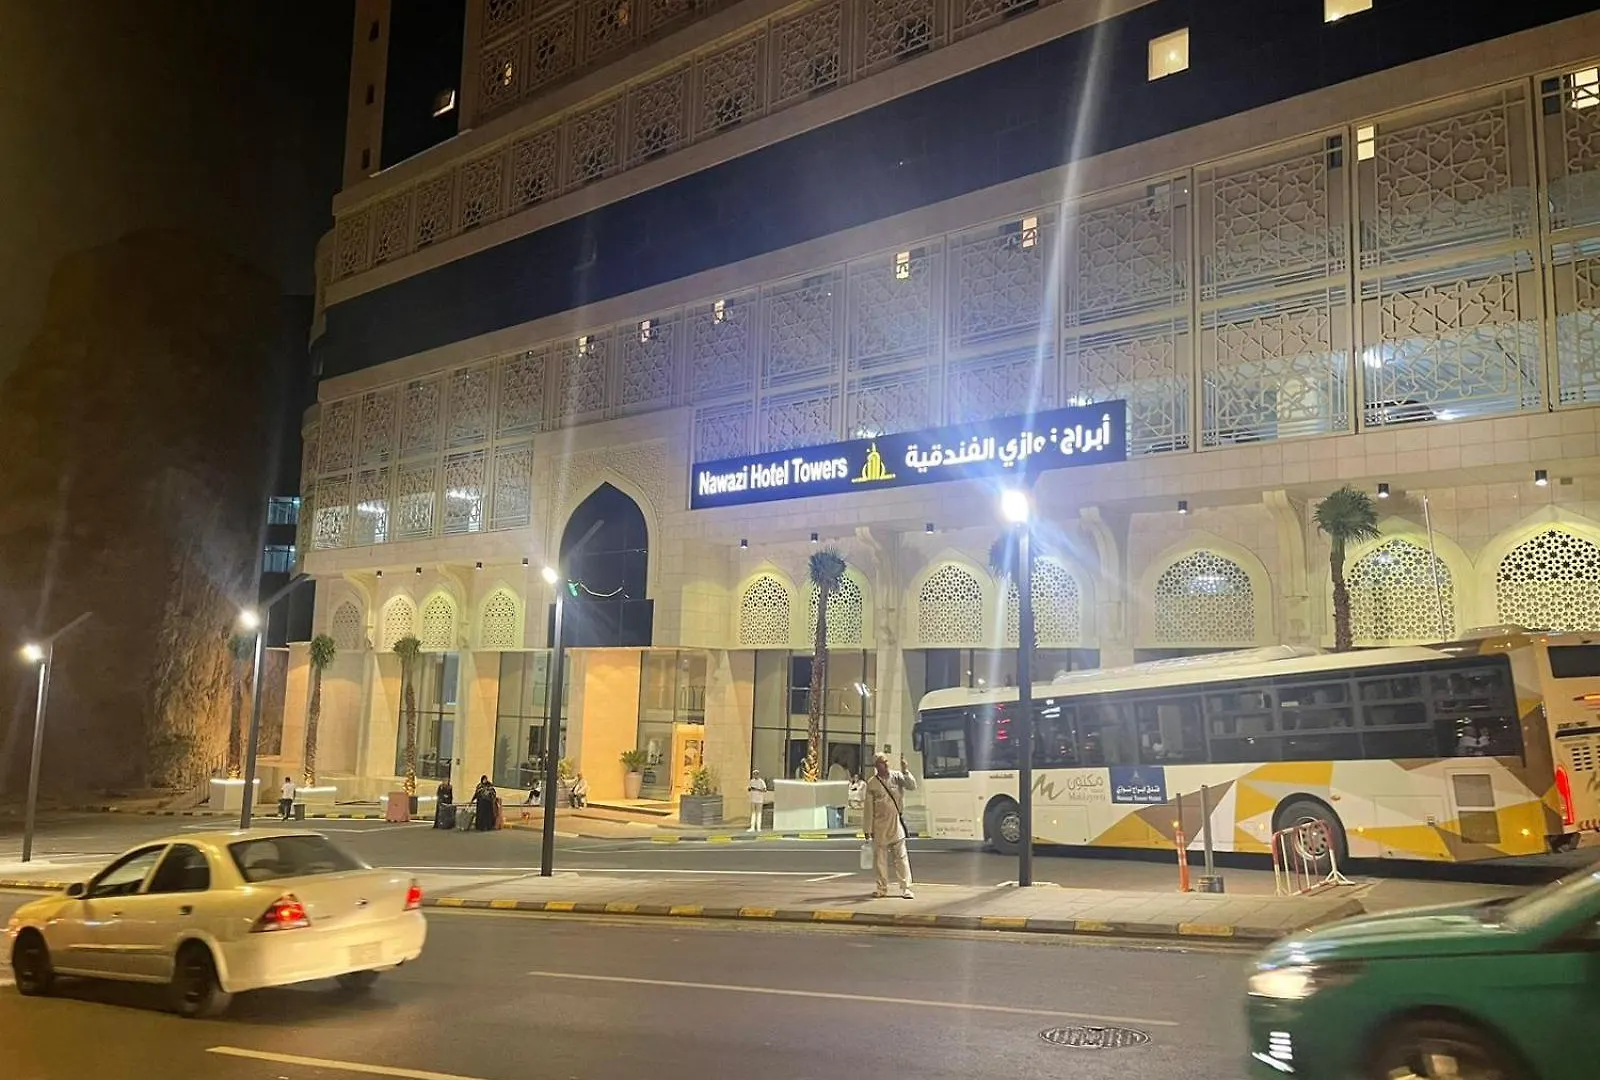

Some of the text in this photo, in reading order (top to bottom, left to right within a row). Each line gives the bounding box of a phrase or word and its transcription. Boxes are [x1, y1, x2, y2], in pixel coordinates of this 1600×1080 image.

[1060, 413, 1110, 455] أبراج
[905, 436, 994, 473] الفندقية
[699, 457, 848, 496] Nawazi Hotel Towers
